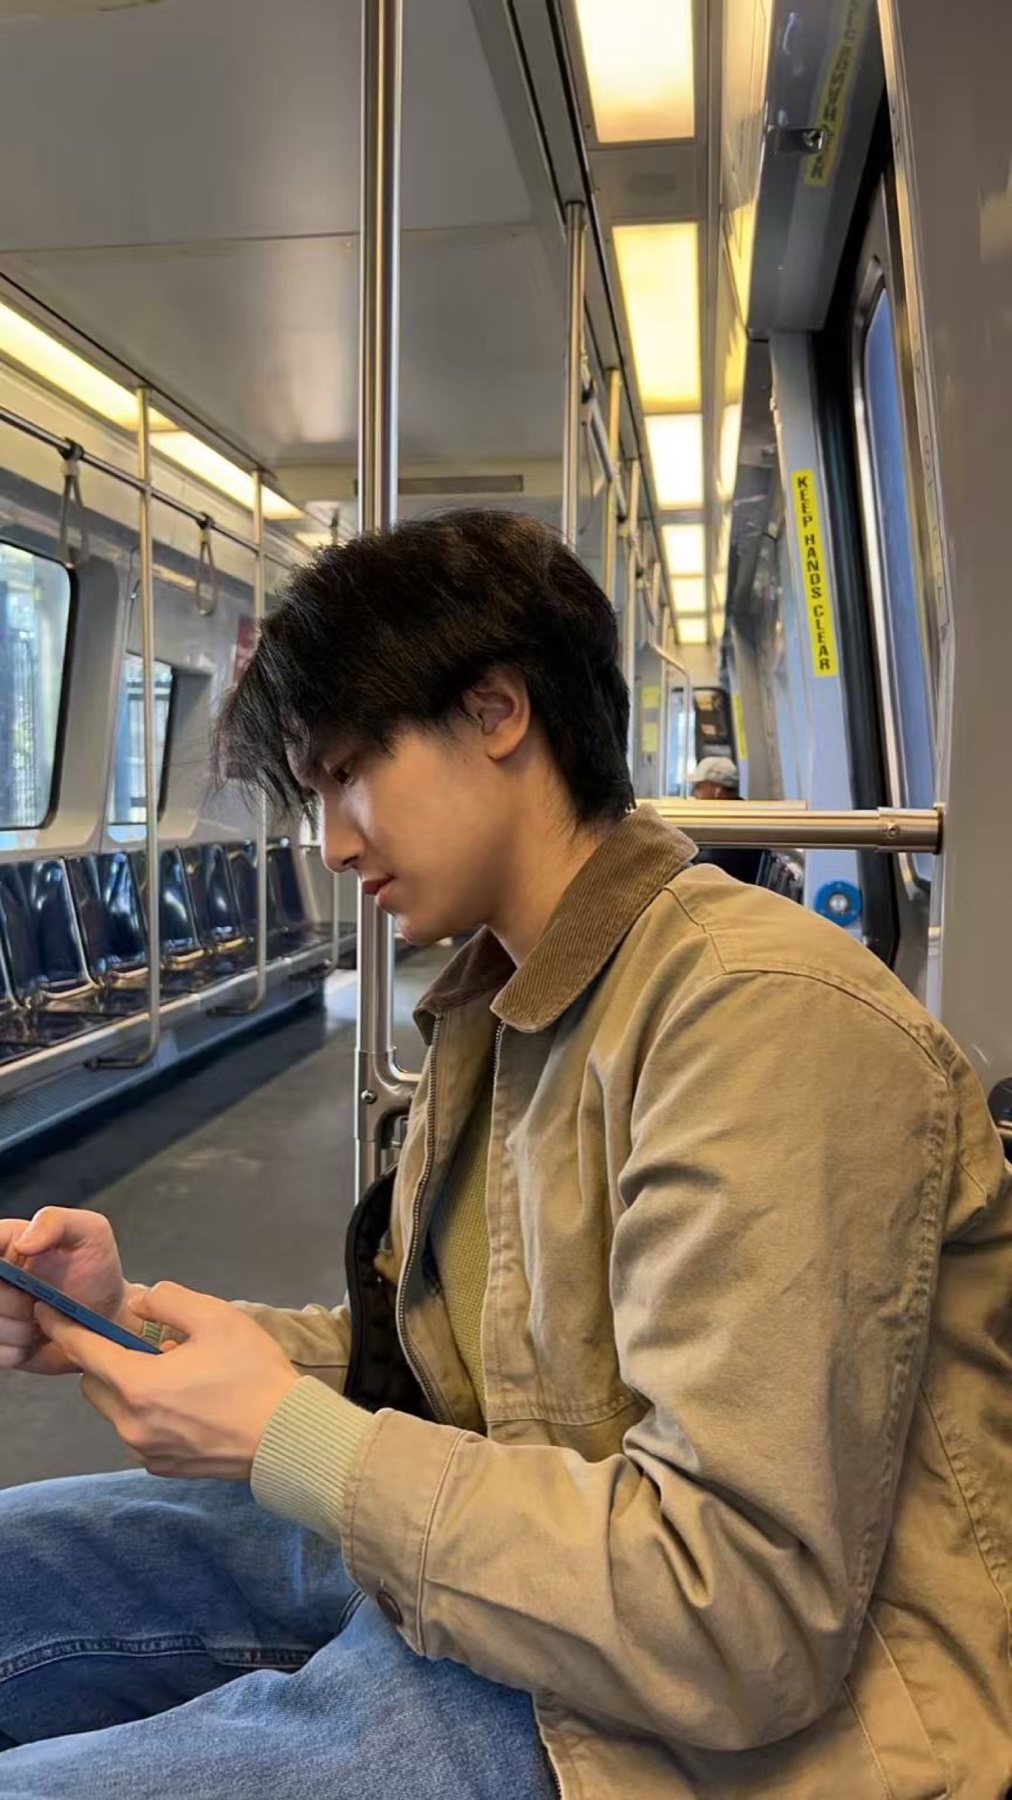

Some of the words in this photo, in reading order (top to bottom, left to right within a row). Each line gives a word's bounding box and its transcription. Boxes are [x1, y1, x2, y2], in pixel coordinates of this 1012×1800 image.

[797, 476, 813, 528] KEEP
[805, 533, 822, 600] HANDS
[813, 604, 831, 671] CLEAR
